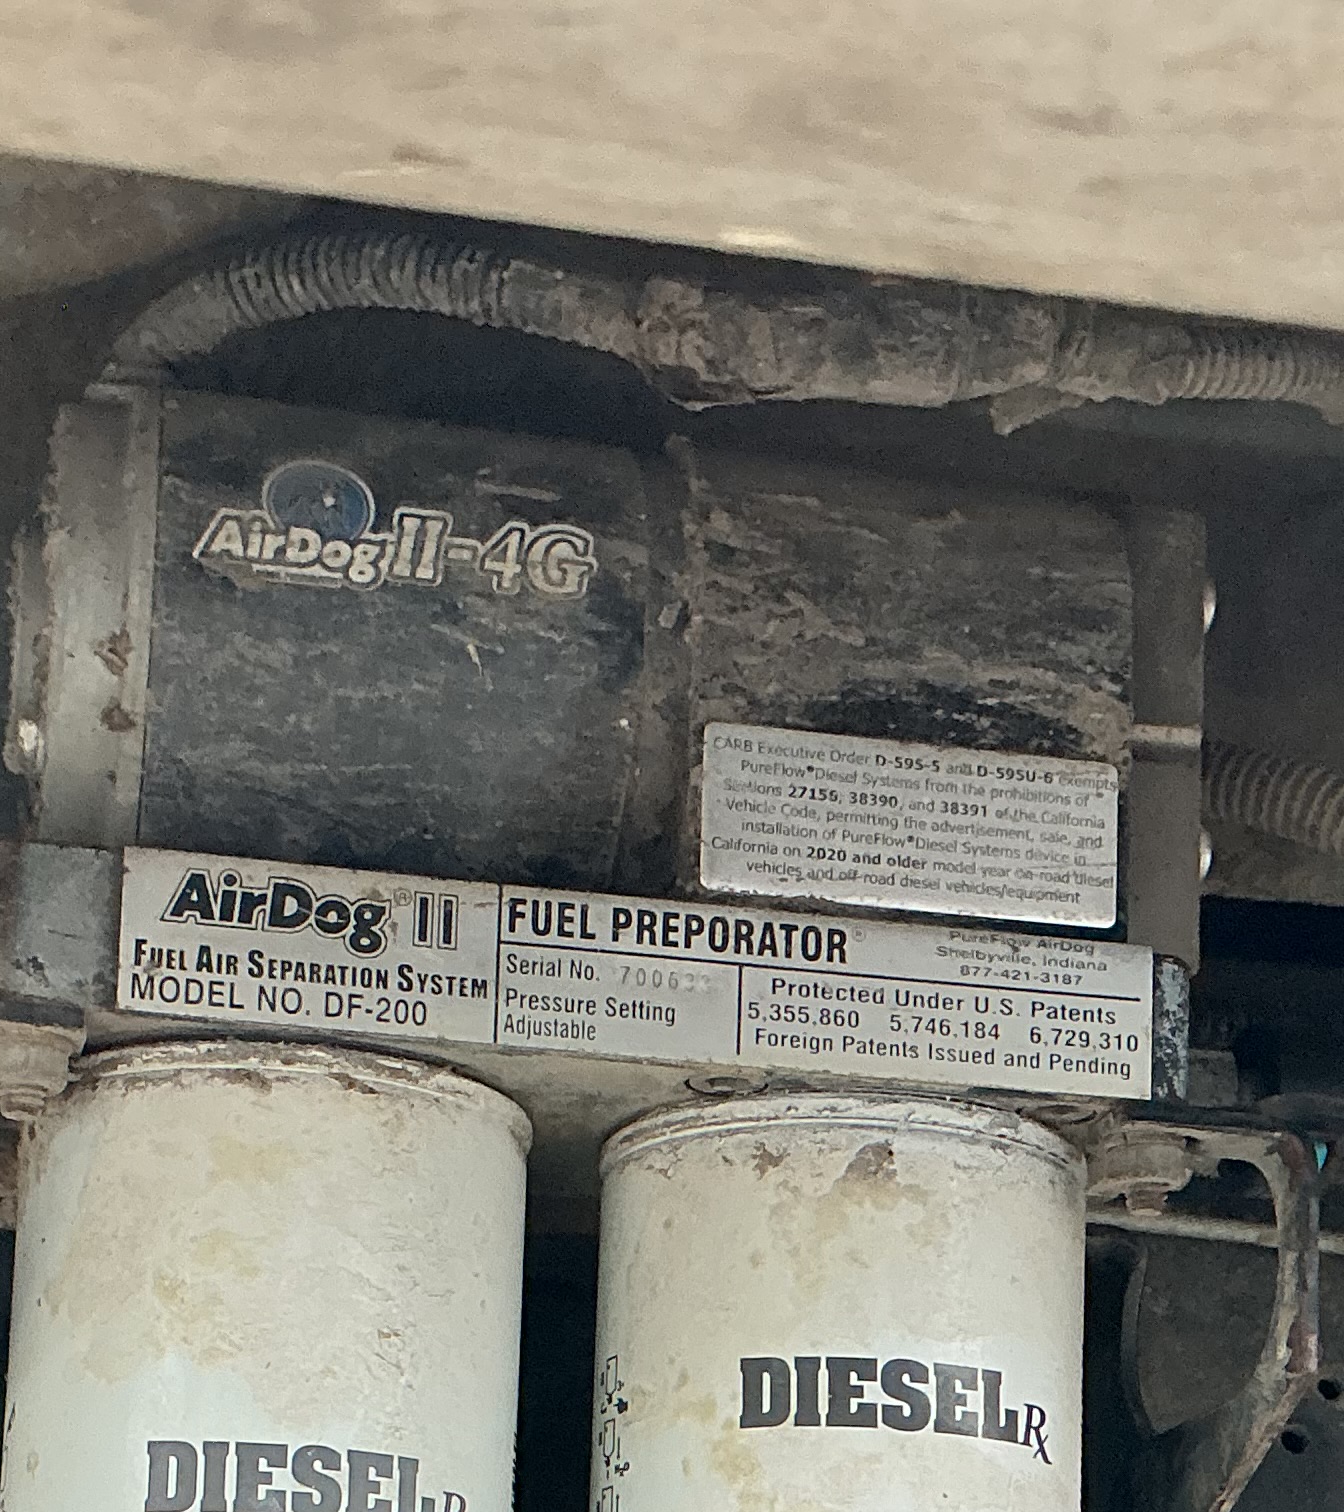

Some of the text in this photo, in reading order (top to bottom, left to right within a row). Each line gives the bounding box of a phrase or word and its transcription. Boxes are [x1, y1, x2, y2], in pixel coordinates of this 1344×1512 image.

[713, 736, 753, 753] CARB
[757, 742, 826, 762] Executive
[830, 750, 870, 765] Order
[875, 754, 940, 773] D-595-5
[977, 765, 1053, 783] D-595U-6
[815, 767, 858, 785] Diesel
[861, 772, 920, 791] Systems
[925, 779, 958, 794] from
[962, 782, 986, 796] the
[990, 786, 1072, 806] prohibitions
[1075, 793, 1091, 807] of
[726, 797, 777, 815] Vehicle
[780, 803, 820, 822] Code,
[826, 809, 898, 831] permitting
[904, 815, 927, 830] the
[1075, 835, 1103, 850] and
[849, 791, 903, 810] 38390,
[908, 800, 935, 813] and
[940, 801, 987, 817] 38391
[995, 807, 1010, 820] of
[1012, 808, 1037, 823] the
[1042, 810, 1106, 830] California
[711, 836, 778, 856] California
[783, 845, 802, 857] on
[807, 847, 847, 862] 2020
[852, 852, 881, 866] and
[887, 855, 927, 870] older
[932, 860, 977, 875] model
[741, 821, 817, 839] installation
[822, 828, 839, 841] of
[915, 837, 958, 853] Diesel
[961, 842, 1021, 860] Systems
[746, 860, 802, 877] vehicles
[807, 867, 833, 881] and
[899, 875, 941, 890] diesel
[412, 890, 459, 951] II
[508, 897, 596, 940] FUEL
[1036, 938, 1095, 956] AirDog
[1043, 956, 1108, 972] Indiana
[506, 953, 711, 994] Serial No. 7006
[960, 965, 1083, 986] 877-421-3187
[130, 974, 428, 1026] MODEL NO. DF-200
[505, 988, 676, 1027] Pressure Setting
[771, 977, 1117, 1026] Protected Under U.S. Patents
[504, 1015, 597, 1041] Adjustable
[747, 1001, 1140, 1053] 5,355,860 5,746,184 6,729,310
[755, 1027, 1133, 1081] Foreign Patents Issued and Pending
